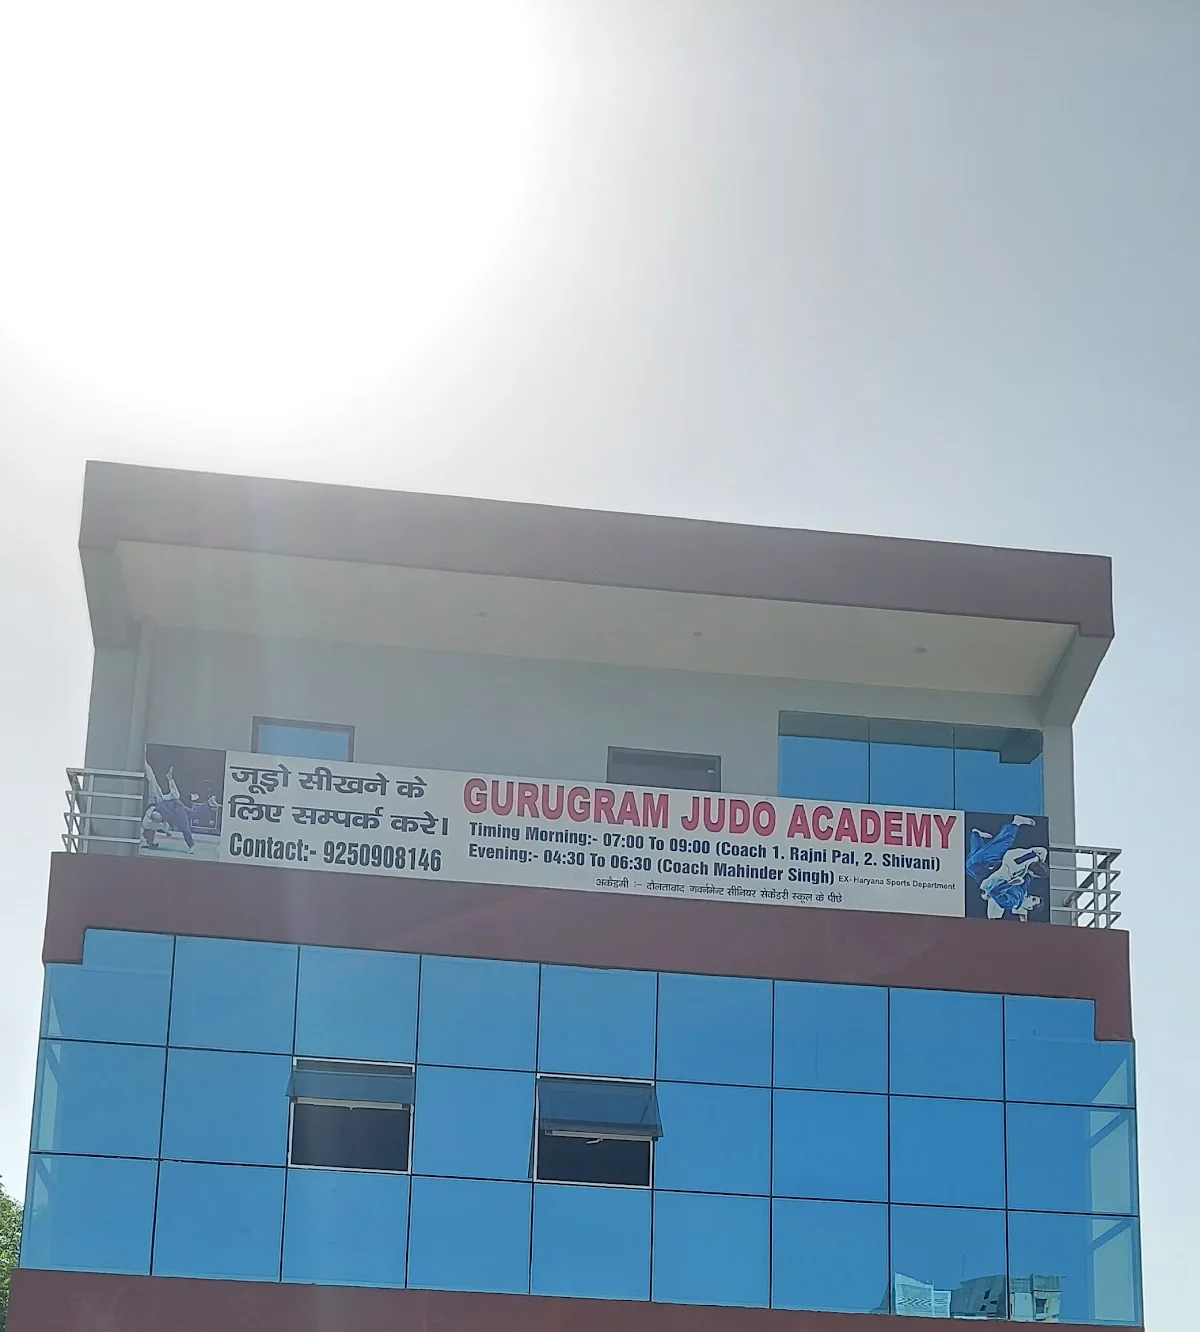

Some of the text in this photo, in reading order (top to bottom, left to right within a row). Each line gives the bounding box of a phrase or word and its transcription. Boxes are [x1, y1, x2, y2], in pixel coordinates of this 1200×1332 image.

[298, 766, 390, 796] सीखने
[396, 775, 427, 799] के
[228, 794, 284, 823] लिए
[291, 806, 384, 829] सम्पर्क
[463, 777, 957, 849] GURUGRAM JUDO ACADEMY
[229, 832, 442, 872] Contact:- 9250908146
[468, 843, 835, 886] Evening:- 04:30 To 06:30 (Coach Mahinder Singh)
[469, 822, 941, 872] Timing Morning:- 07:00 To 09:00 (Coach 1. Rajni Pal, 2. Shivani)
[792, 891, 813, 904] स्कूल
[815, 891, 825, 902] के
[827, 890, 843, 903] पीछे
[853, 876, 884, 886] Haryana
[886, 878, 911, 888] Sports
[912, 880, 956, 890] Department
